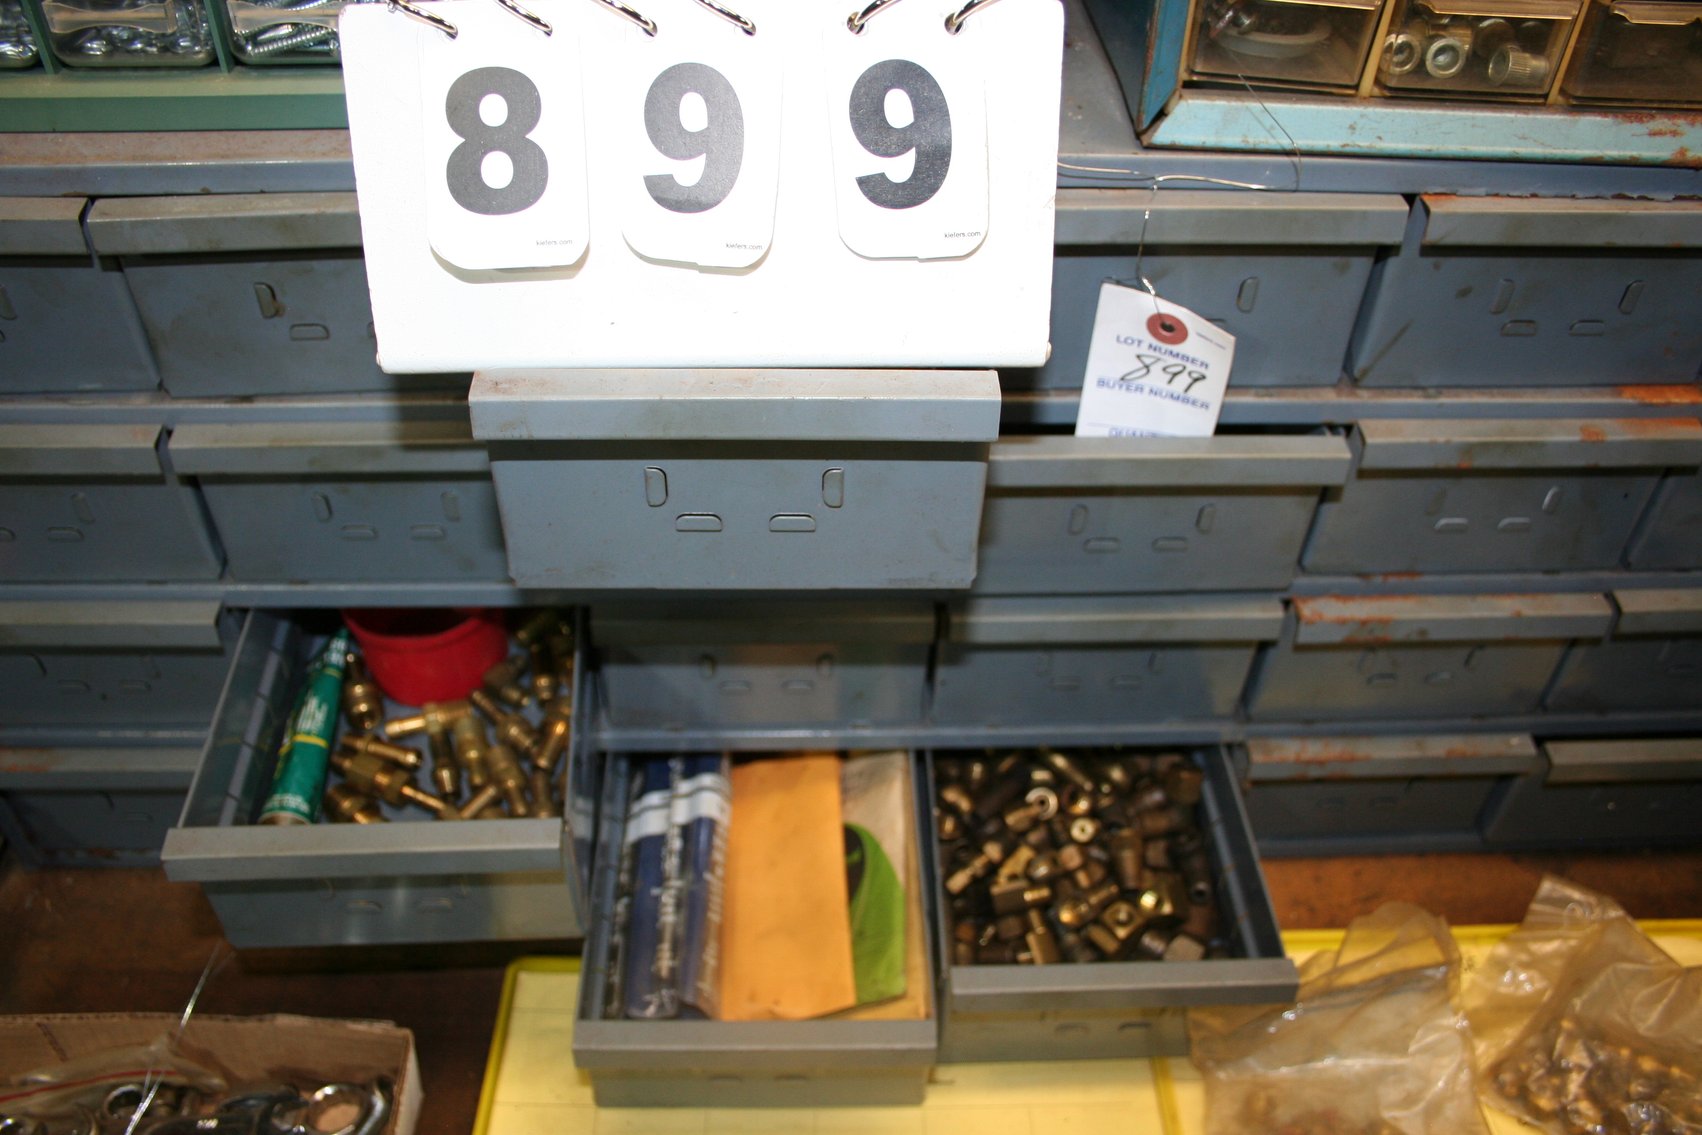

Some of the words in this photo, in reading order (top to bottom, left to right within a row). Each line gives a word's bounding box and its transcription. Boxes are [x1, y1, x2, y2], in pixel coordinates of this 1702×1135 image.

[446, 66, 549, 215] 8
[643, 62, 745, 214] 9
[849, 58, 953, 210] 9
[1115, 334, 1143, 348] LOT
[1147, 343, 1209, 370] NUMBER
[1120, 353, 1206, 394] 899
[1096, 376, 1145, 394] BUYER
[1149, 386, 1210, 411] NUMBER
